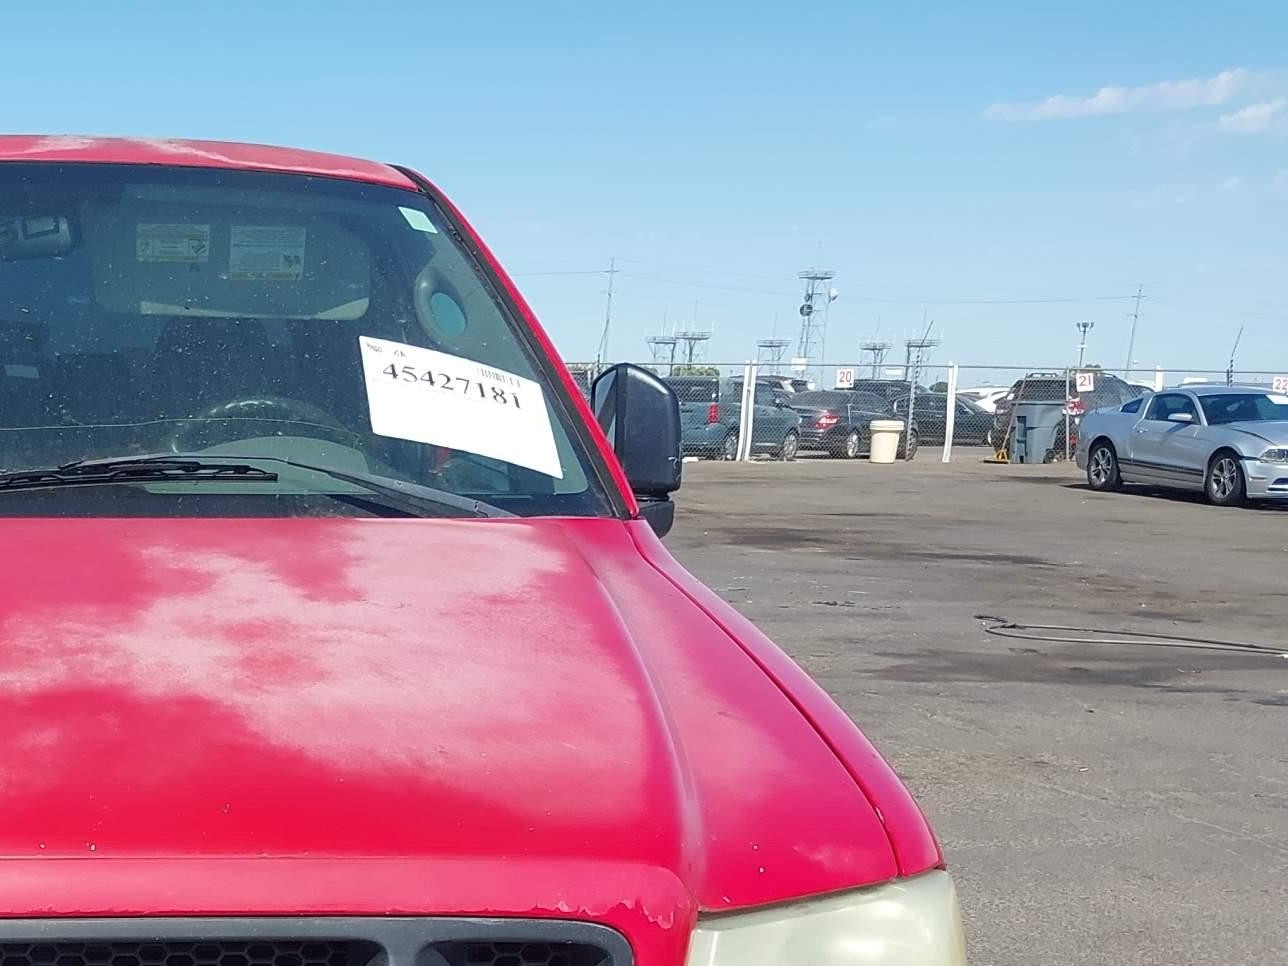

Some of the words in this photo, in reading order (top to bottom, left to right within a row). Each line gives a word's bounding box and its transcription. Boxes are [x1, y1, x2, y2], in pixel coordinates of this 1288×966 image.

[839, 370, 852, 383] 20
[1078, 375, 1091, 387] 21
[382, 363, 521, 409] 45427181
